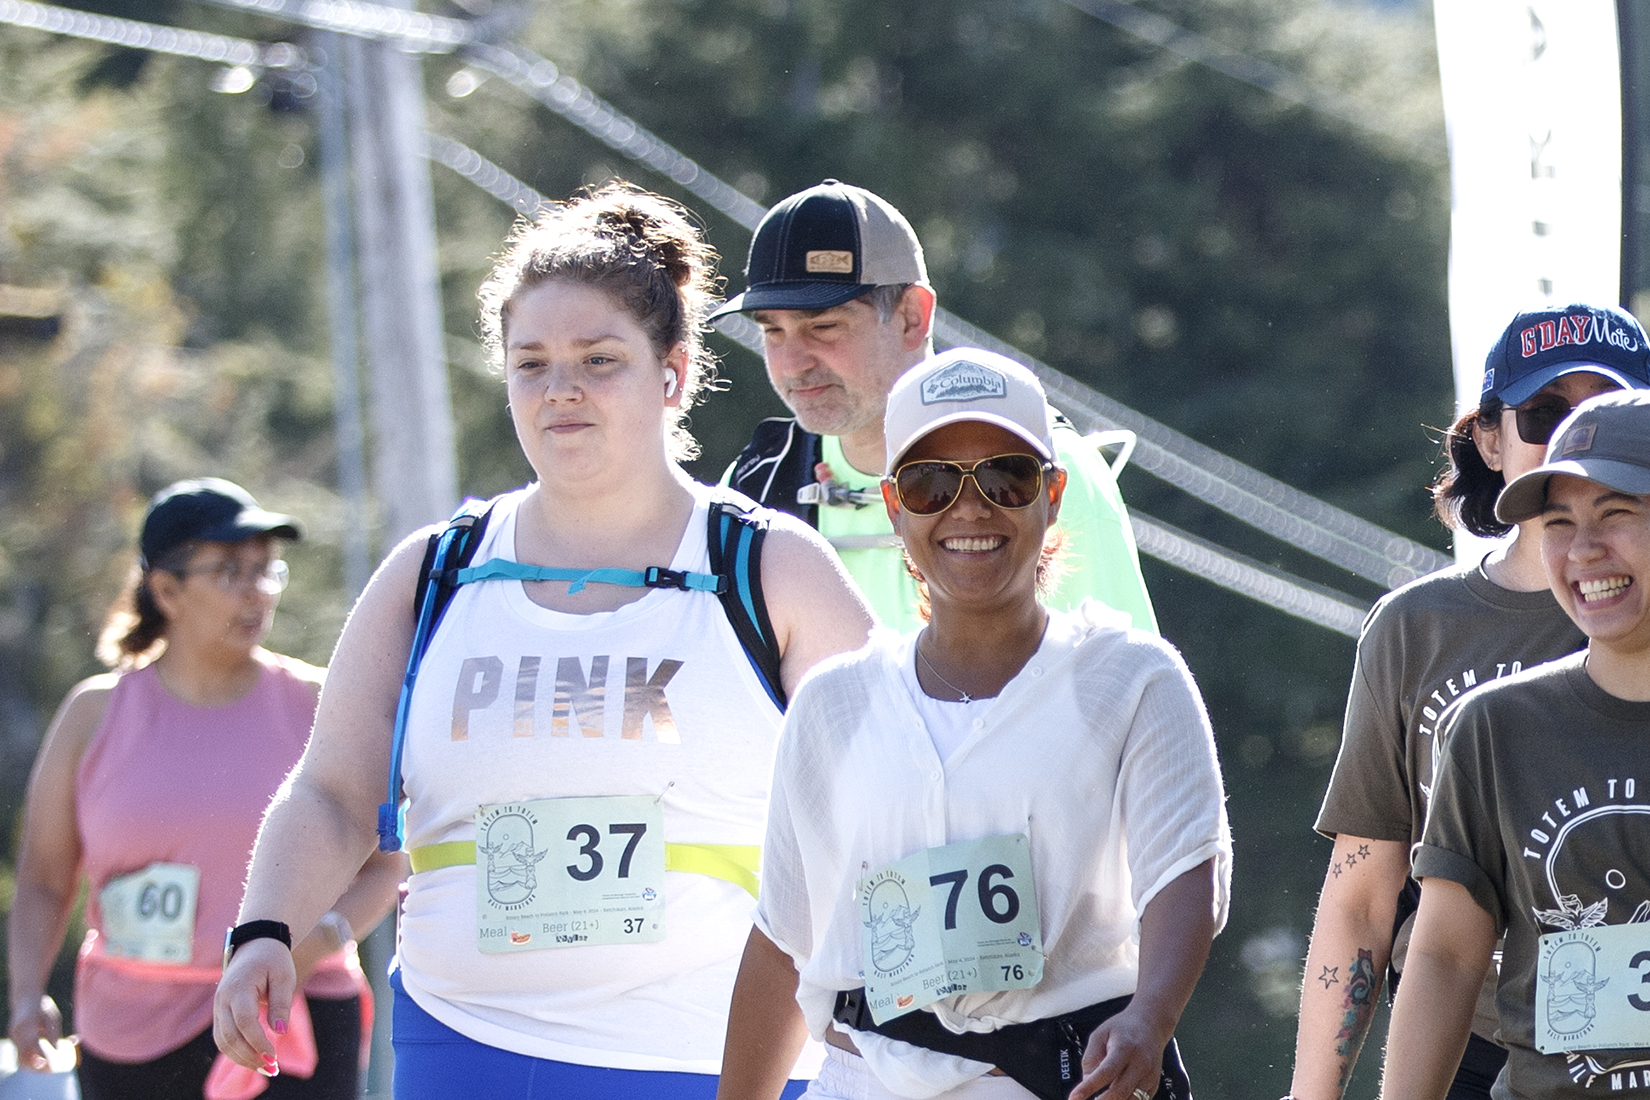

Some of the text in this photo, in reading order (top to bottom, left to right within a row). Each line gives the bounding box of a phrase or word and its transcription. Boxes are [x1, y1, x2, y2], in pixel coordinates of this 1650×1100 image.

[1520, 315, 1638, 358] G'DAY Mate
[940, 372, 1001, 390] Columbia
[451, 655, 684, 744] PINK
[1418, 660, 1522, 736] TOTEM TO
[1523, 786, 1590, 860] TOTEM
[1607, 778, 1636, 799] TO
[566, 823, 647, 882] 37
[137, 880, 183, 922] 60
[929, 863, 1020, 930] 76
[480, 918, 645, 939] Meal Beer (21+) 37
[922, 973, 945, 991] Beer
[947, 967, 977, 982] (21+)
[1001, 964, 1024, 982] 76
[869, 996, 894, 1011] Meal
